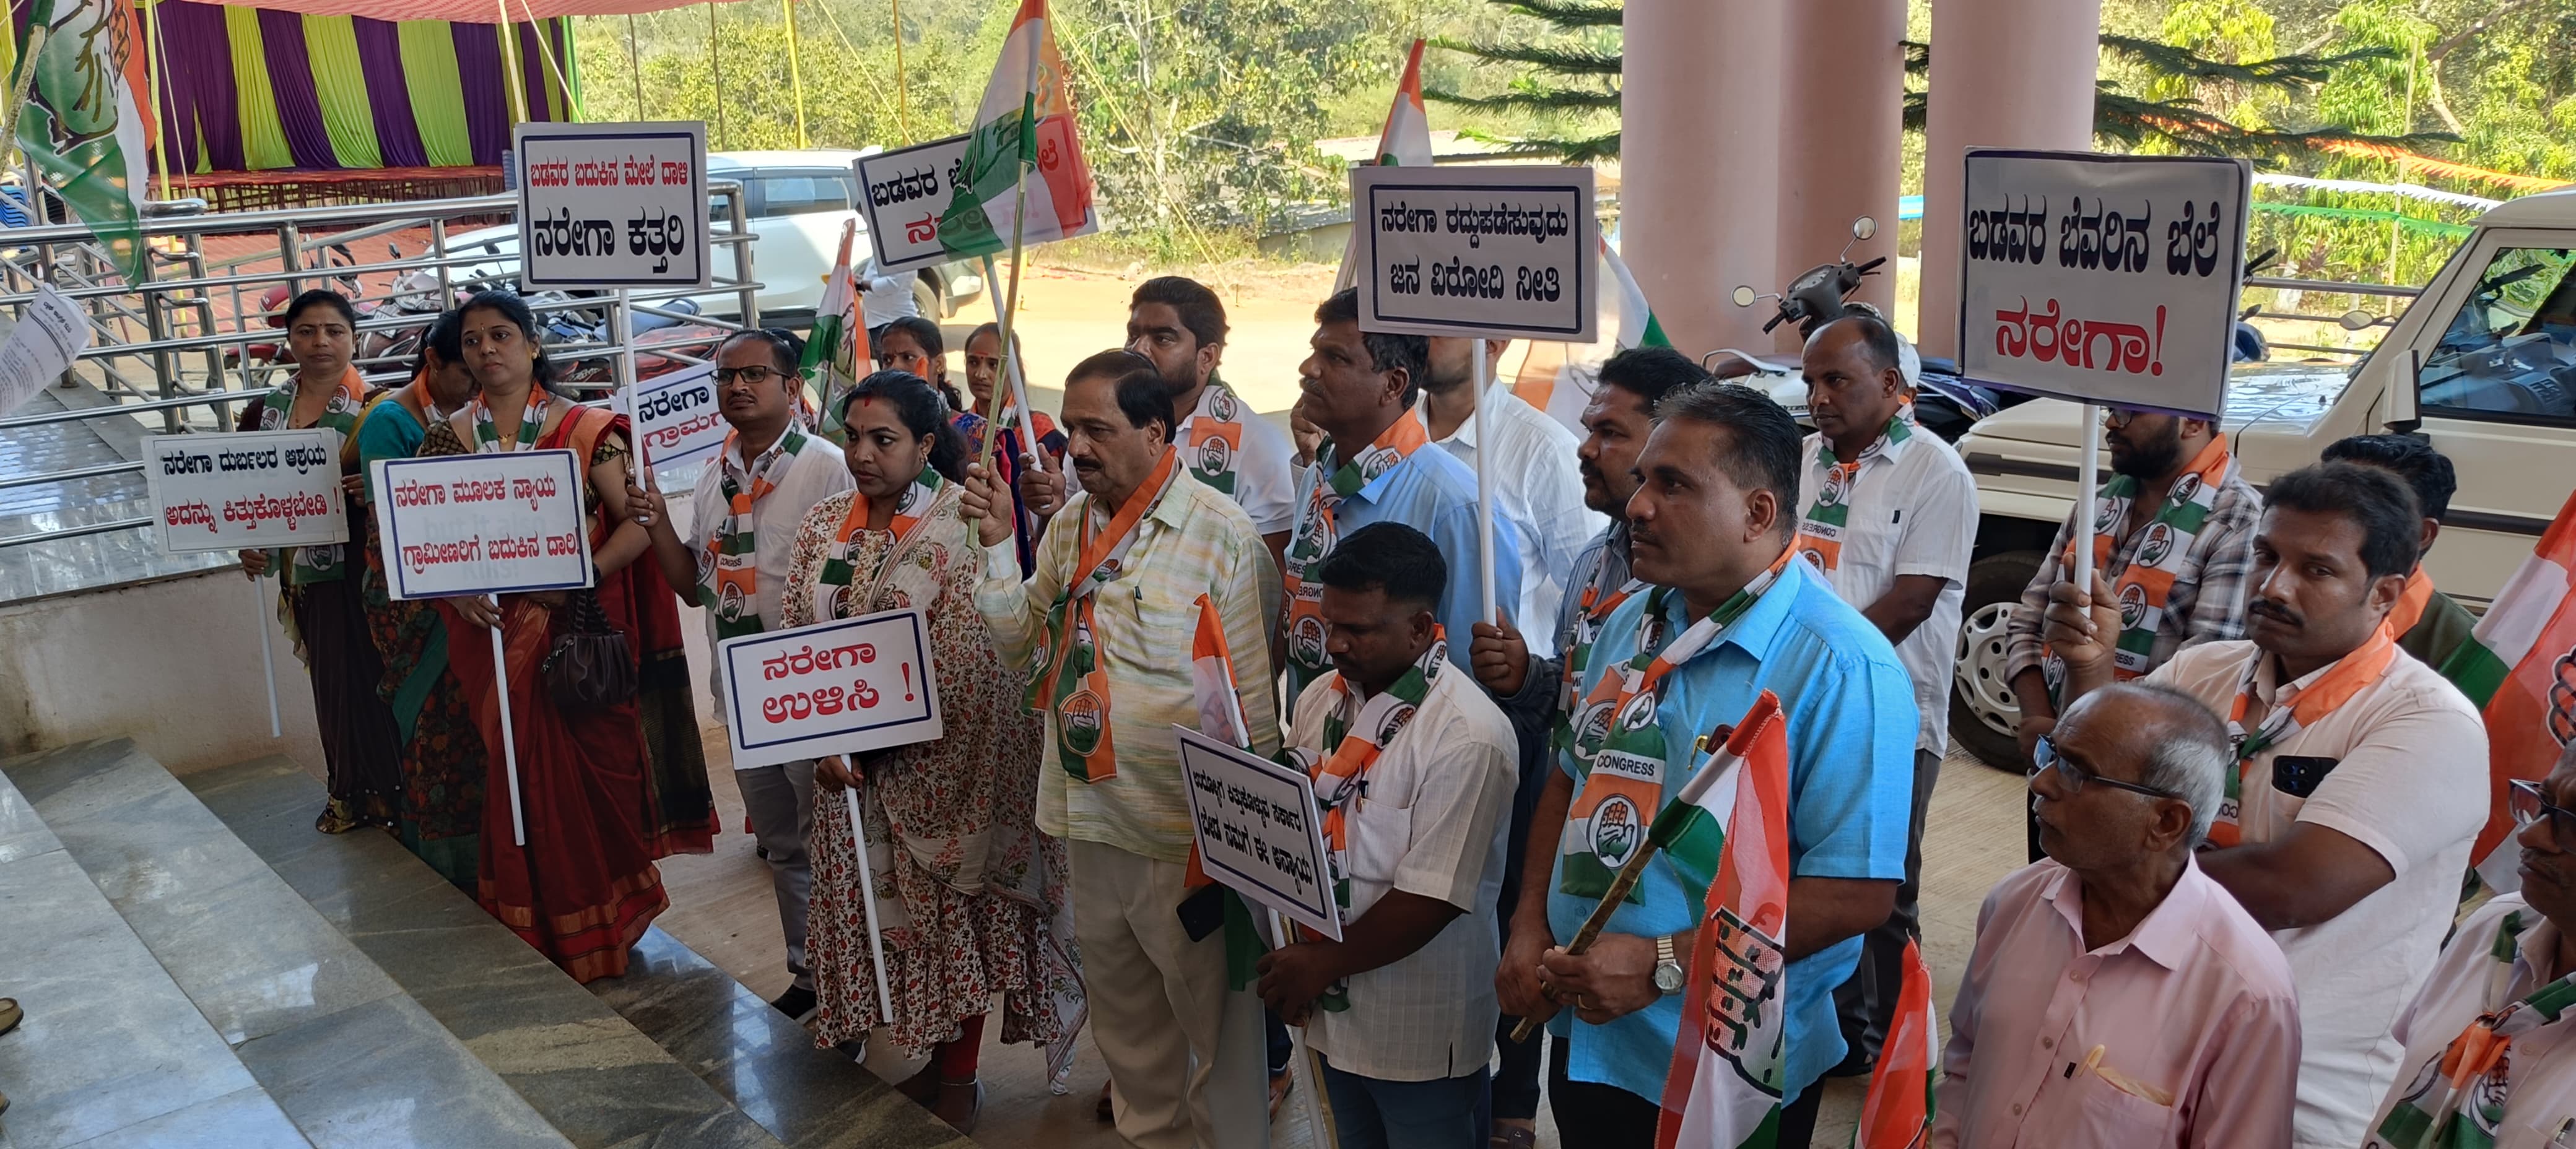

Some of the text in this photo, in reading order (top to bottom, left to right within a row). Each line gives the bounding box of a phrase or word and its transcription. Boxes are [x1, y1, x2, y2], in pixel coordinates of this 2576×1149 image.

[531, 154, 687, 186] ಬಡವರ ಬದುಕಿನ ಮೇಲೆ ದಾಳಿ
[871, 163, 939, 207] ಬಡವರ
[534, 206, 684, 274] ನರೇಗಾ ಕತ್ತರಿ
[1382, 201, 1569, 249] ನರೇಗಾ ರದ್ದುಪಡೆಸುವುದು
[1969, 193, 2220, 277] ಬಡವರ ಬೆವರಿನ ಬೆಲೆ
[1390, 254, 1420, 295] ಜನ
[1516, 266, 1560, 302] ನೀತಿ
[1996, 295, 2166, 376] ನರೇಗಾ!
[638, 386, 710, 423] ನರೇಗಾ
[162, 441, 327, 475] ನರೇಗಾ ದುರ್ಬಲರ ಆಶ್ರಯ
[165, 497, 218, 534] ಅದನ್ನು
[223, 491, 328, 531] ಕಿತ್ತುಕೊಳ್ಳಬೇಡಿ
[394, 471, 556, 511] ನರೇಗಾ ಮೂಲಕ ನ್ಯಾಯ
[403, 534, 481, 574] ಗ್ರಾಮೀಣರಿಗೆ
[489, 531, 539, 559] ಬದುಕಿನ
[762, 643, 877, 680] ನರೇಗಾ
[2115, 650, 2134, 666] RESS
[762, 662, 915, 724] ಉಳಿಸಿ !
[1596, 754, 1655, 778] CONGRESS
[1224, 822, 1253, 857] ನಮಗೆ
[1271, 844, 1313, 895] ಅನ್ಯಾಯ
